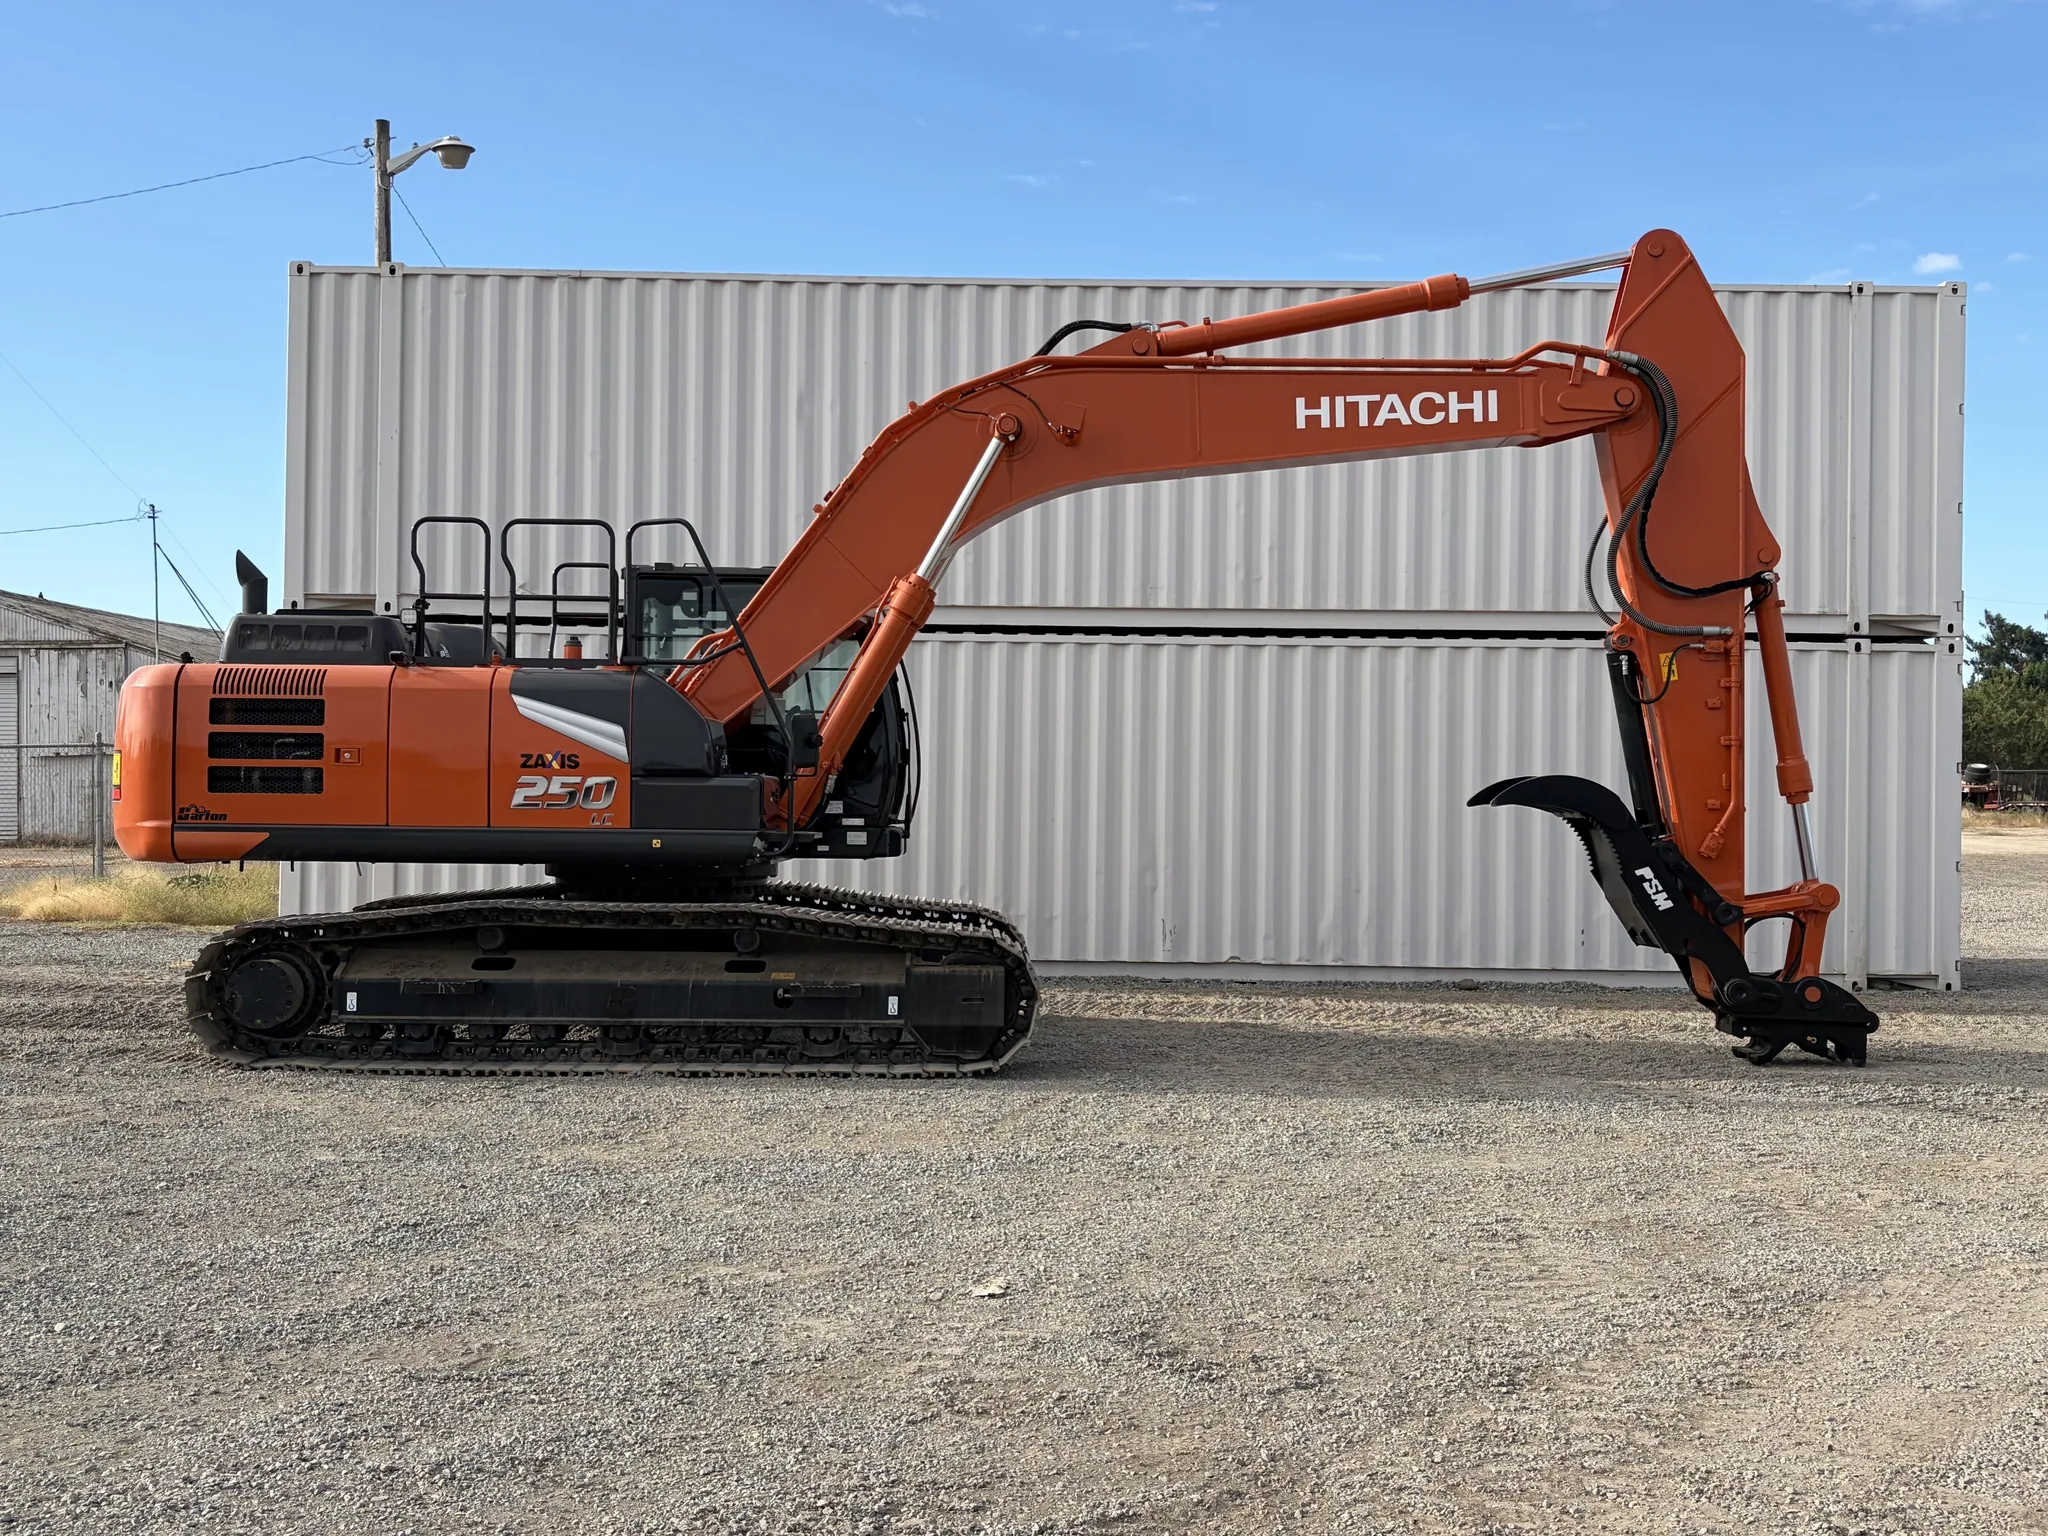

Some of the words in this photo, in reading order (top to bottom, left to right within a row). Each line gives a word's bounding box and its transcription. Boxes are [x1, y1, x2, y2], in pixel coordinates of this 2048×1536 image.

[1295, 389, 1498, 429] HITACHI
[520, 750, 580, 770] ZAXIS
[510, 775, 618, 810] 250
[590, 813, 614, 826] LC
[1634, 866, 1674, 911] PSM
